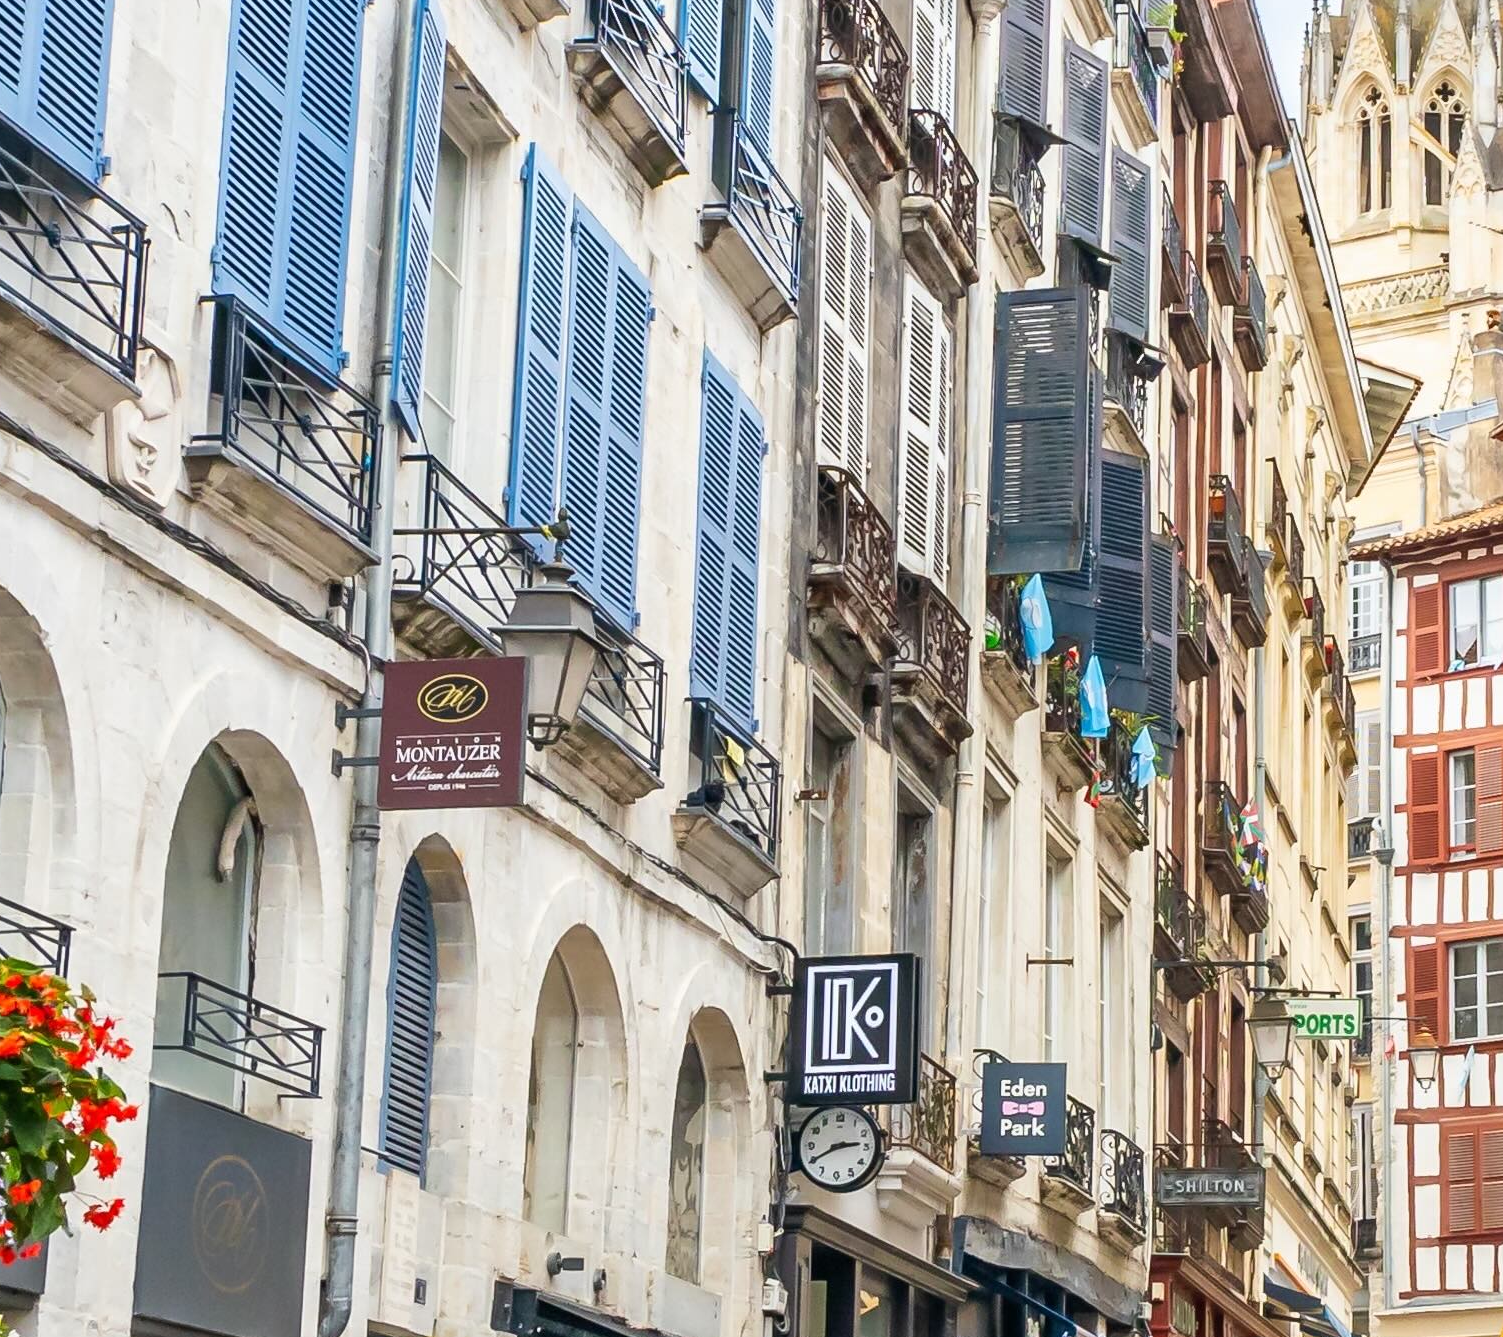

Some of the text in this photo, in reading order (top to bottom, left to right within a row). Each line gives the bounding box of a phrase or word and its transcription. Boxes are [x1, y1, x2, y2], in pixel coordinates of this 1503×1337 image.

[395, 735, 502, 746] MAISON
[395, 744, 502, 764] MONTAUZER
[391, 763, 501, 782] Artisan charcutier
[428, 783, 451, 791] DEPUIS
[1295, 1013, 1355, 1036] PORTS
[804, 1072, 896, 1095] KATXI KLOTHING
[1000, 1077, 1048, 1098] Eden
[1000, 1116, 1046, 1137] Park
[1174, 1179, 1246, 1195] SHILTON
